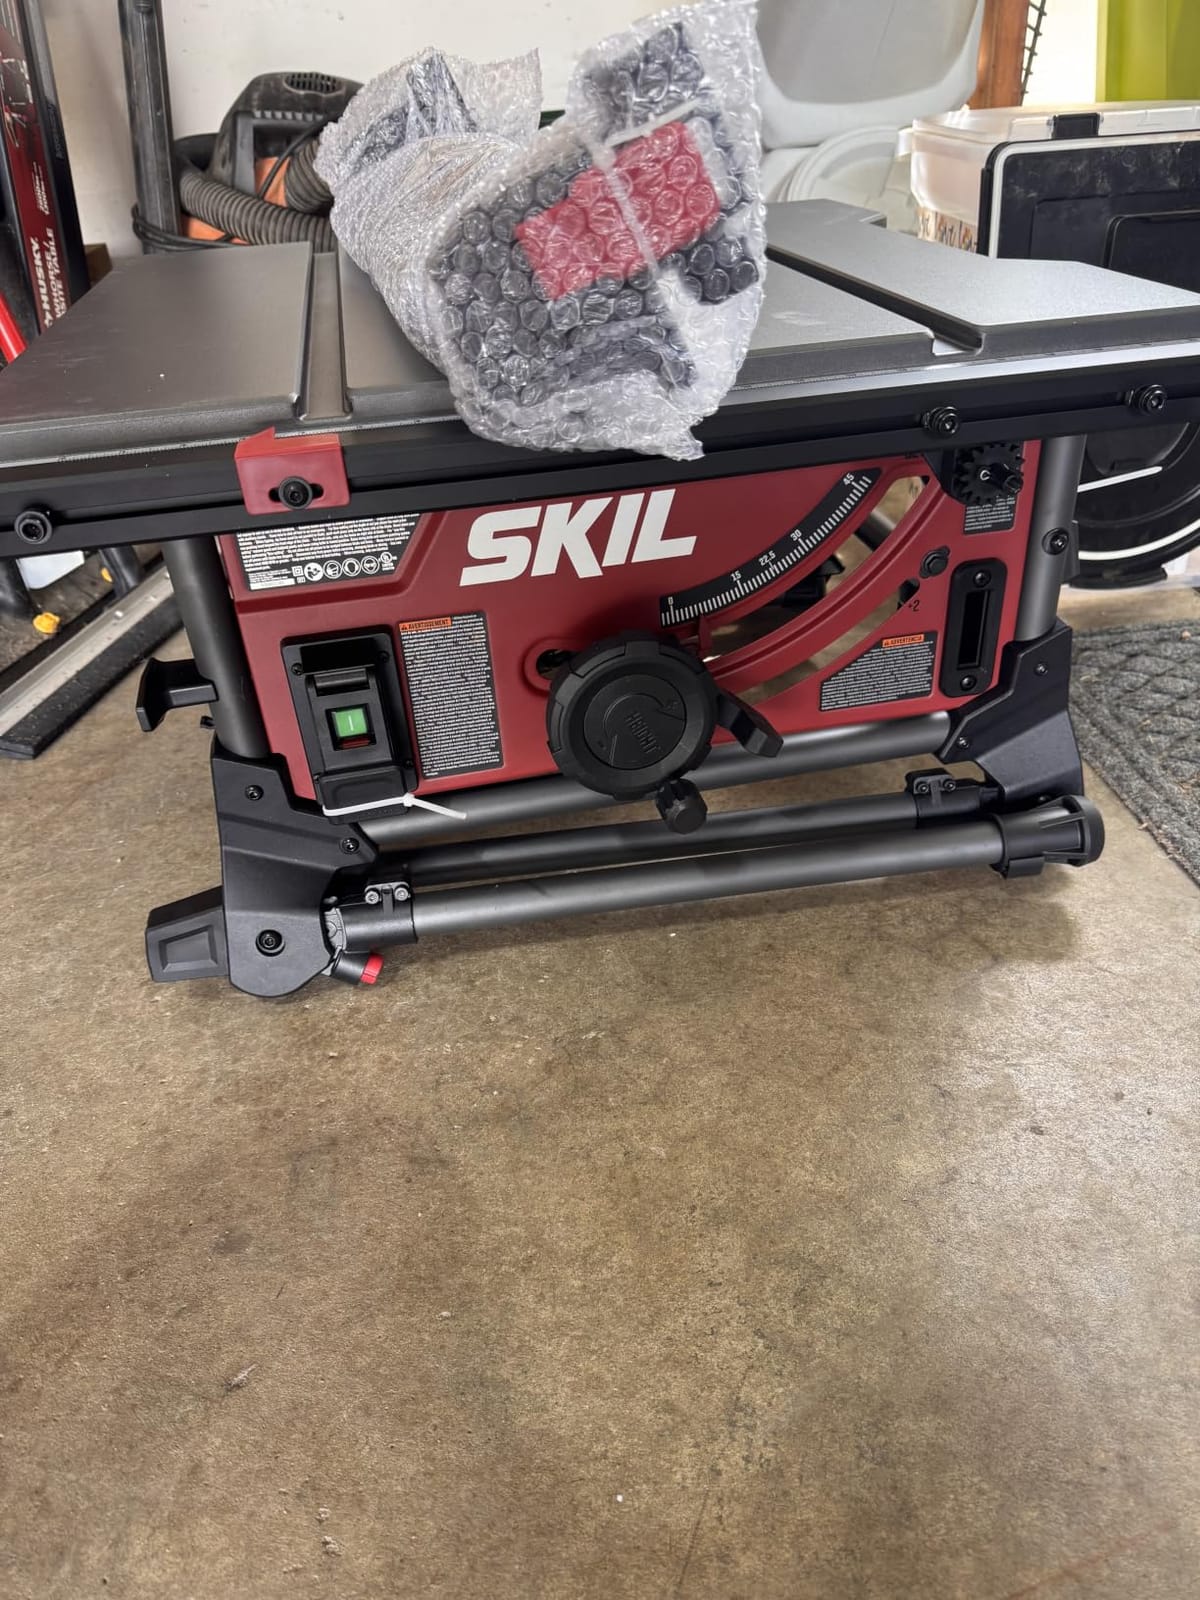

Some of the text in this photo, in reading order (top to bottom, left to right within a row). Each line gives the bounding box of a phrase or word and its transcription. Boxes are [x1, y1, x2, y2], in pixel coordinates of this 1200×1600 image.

[30, 236, 51, 312] HUSKY
[46, 227, 60, 275] TABLE
[459, 488, 697, 587] SKIL
[730, 570, 741, 581] 15
[758, 551, 776, 566] 22.5
[790, 529, 802, 541] 30
[843, 473, 855, 486] 45
